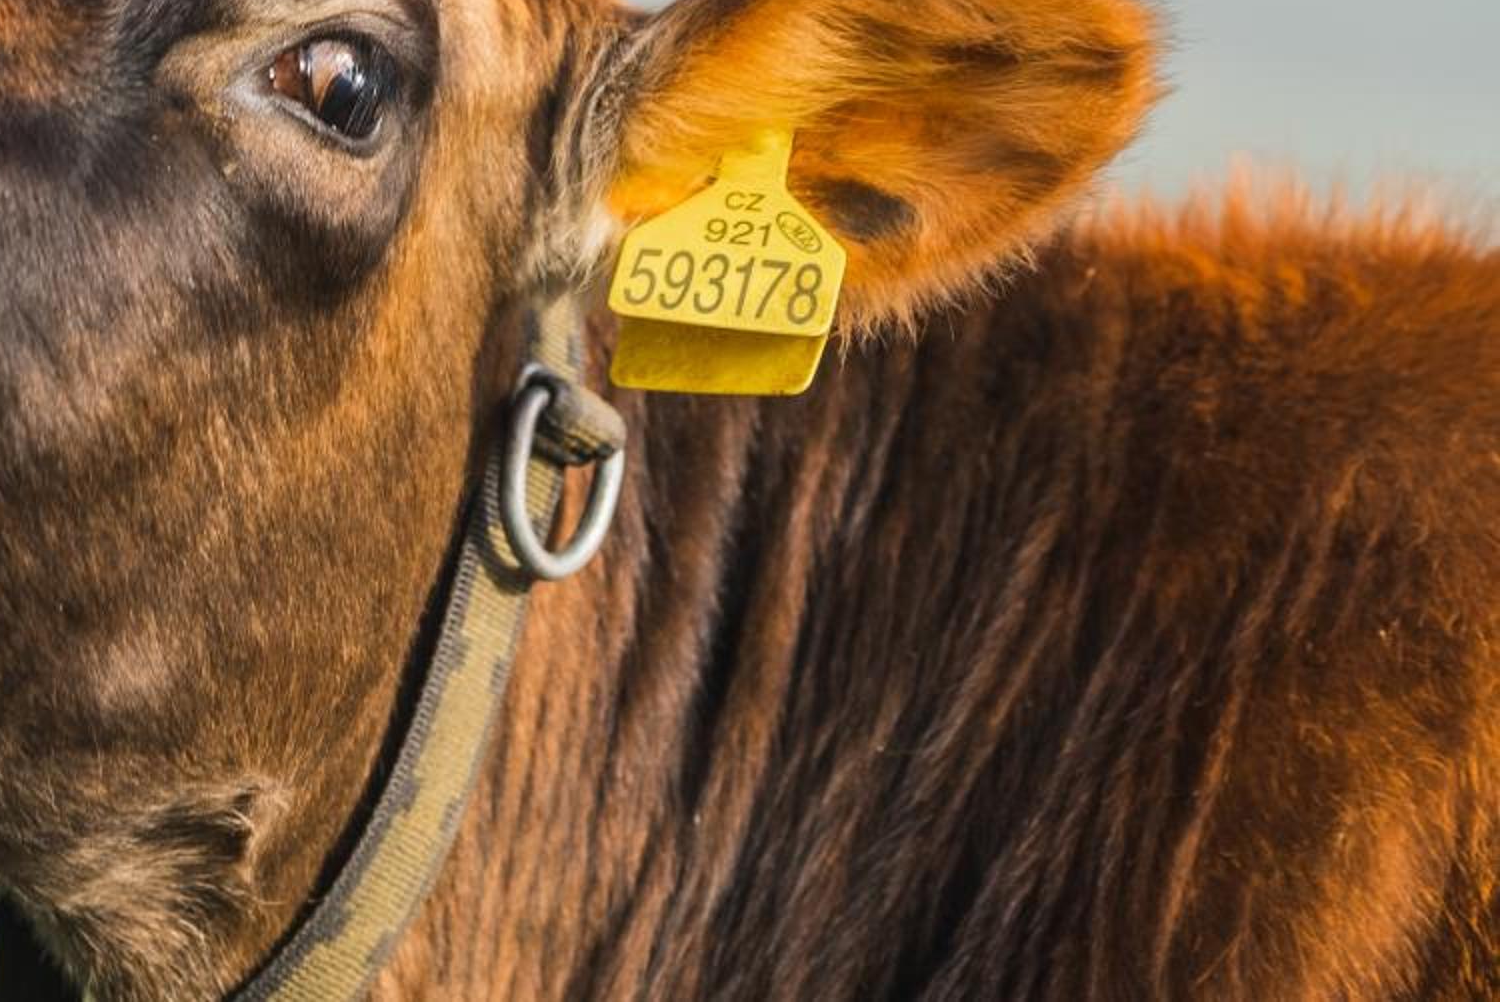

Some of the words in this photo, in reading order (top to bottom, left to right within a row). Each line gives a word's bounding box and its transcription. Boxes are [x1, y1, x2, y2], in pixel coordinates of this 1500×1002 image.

[724, 191, 767, 213] CZ
[703, 218, 773, 248] 921
[623, 248, 823, 326] 593178
